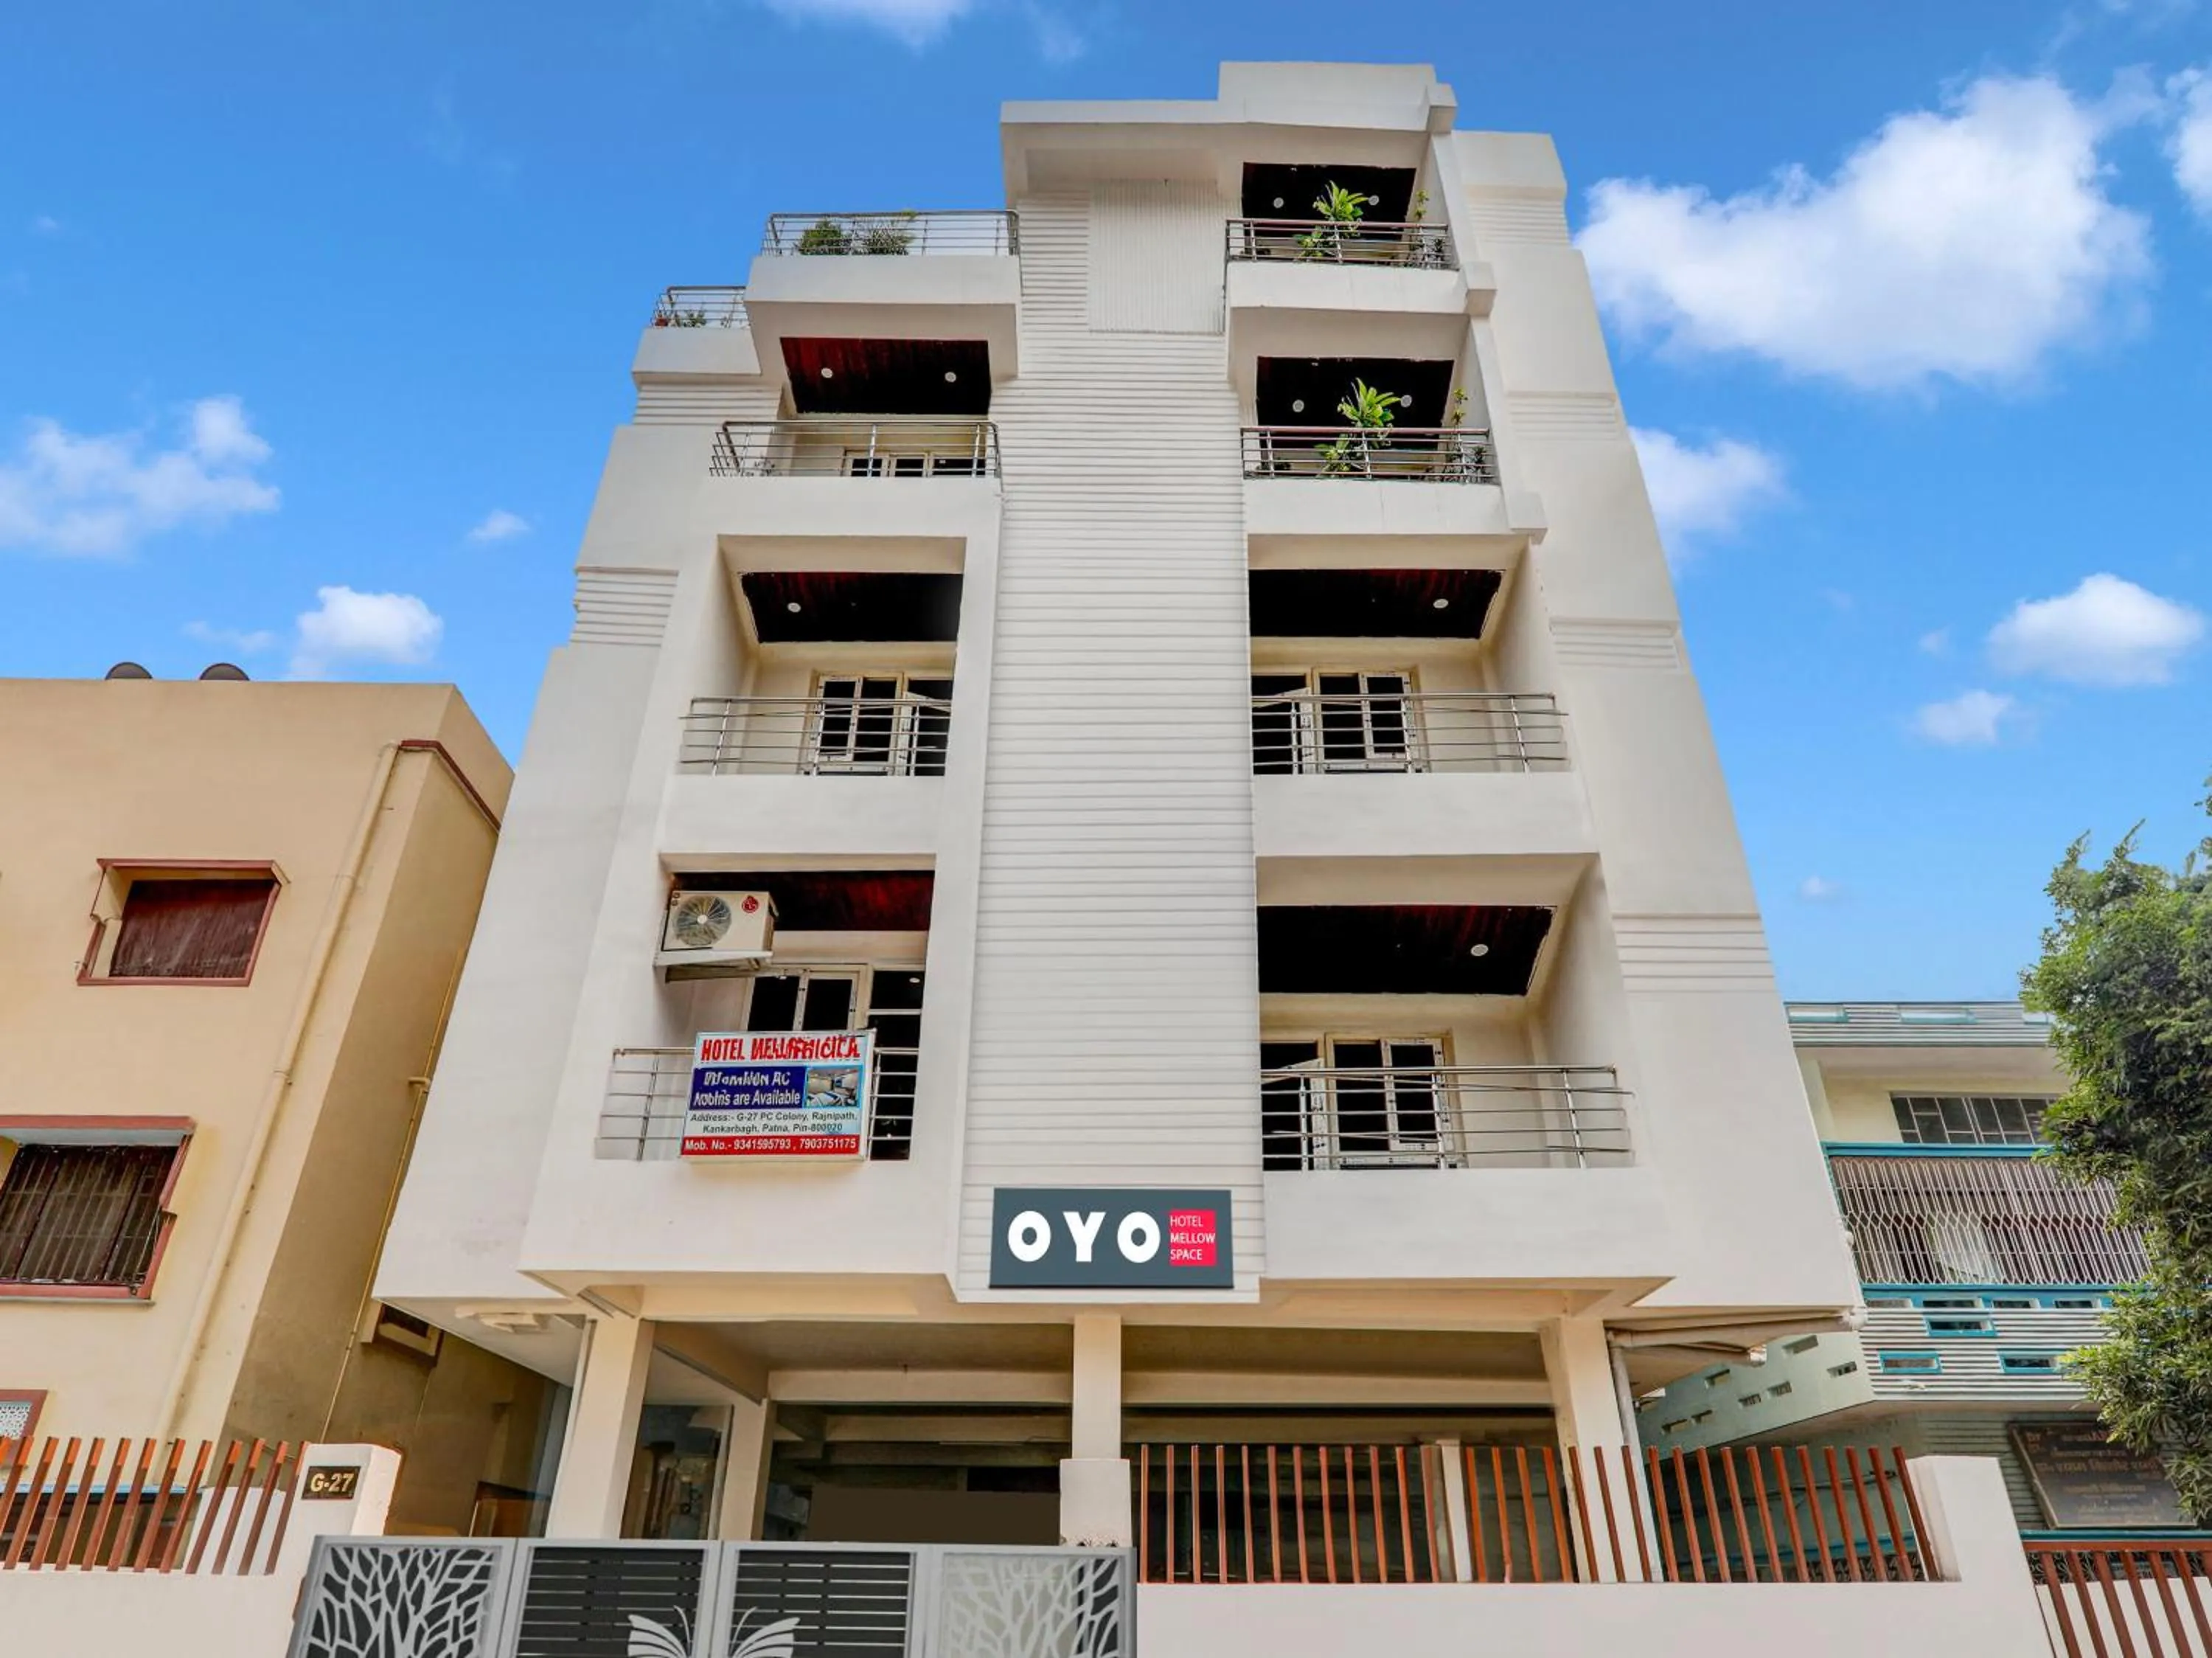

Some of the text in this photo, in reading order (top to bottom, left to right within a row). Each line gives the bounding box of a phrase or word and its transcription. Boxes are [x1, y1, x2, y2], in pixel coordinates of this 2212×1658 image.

[701, 1038, 745, 1061] HOTEL
[772, 1072, 791, 1086] AC
[733, 1093, 751, 1105] are
[751, 1089, 801, 1105] Available
[737, 1112, 758, 1121] G-27
[760, 1112, 773, 1120] PC
[685, 1139, 708, 1151] Mob.
[799, 1138, 857, 1149] 7903751175
[1169, 1215, 1203, 1228] HOTEL
[1008, 1210, 1161, 1263] OYO
[1169, 1232, 1216, 1244] MELLOW
[1169, 1249, 1203, 1261] SPACE
[310, 1473, 355, 1492] G-27
